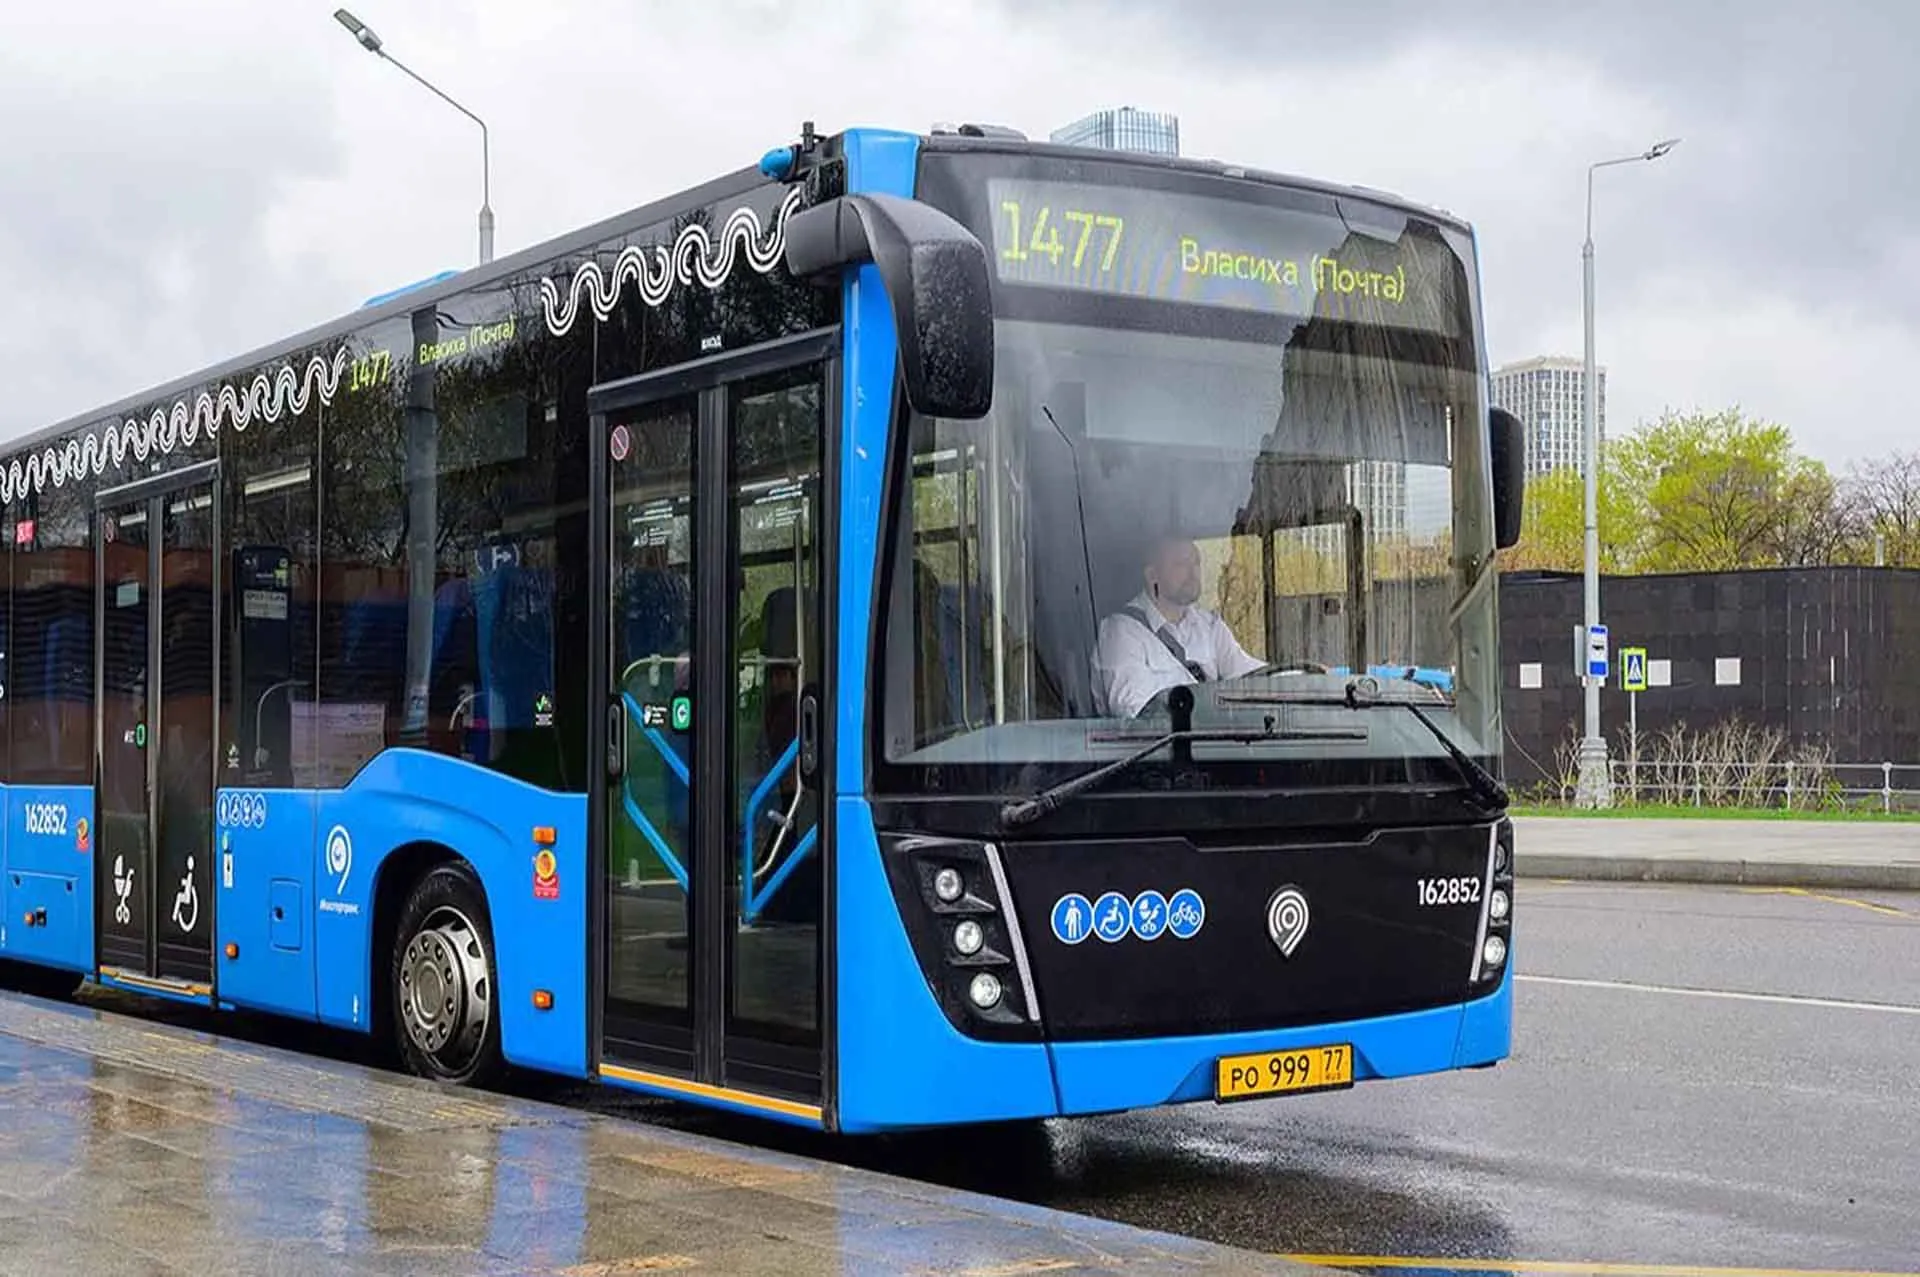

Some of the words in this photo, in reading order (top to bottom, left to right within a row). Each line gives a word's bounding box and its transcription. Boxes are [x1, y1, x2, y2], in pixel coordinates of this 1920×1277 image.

[1001, 200, 1124, 271] 1477
[1180, 235, 1299, 286] Власиха
[1310, 252, 1405, 303] (Почта)
[350, 350, 391, 392] 1477
[25, 803, 68, 835] 162852
[1417, 876, 1480, 905] 162852
[1268, 1054, 1310, 1087] 999
[1323, 1048, 1343, 1072] 77
